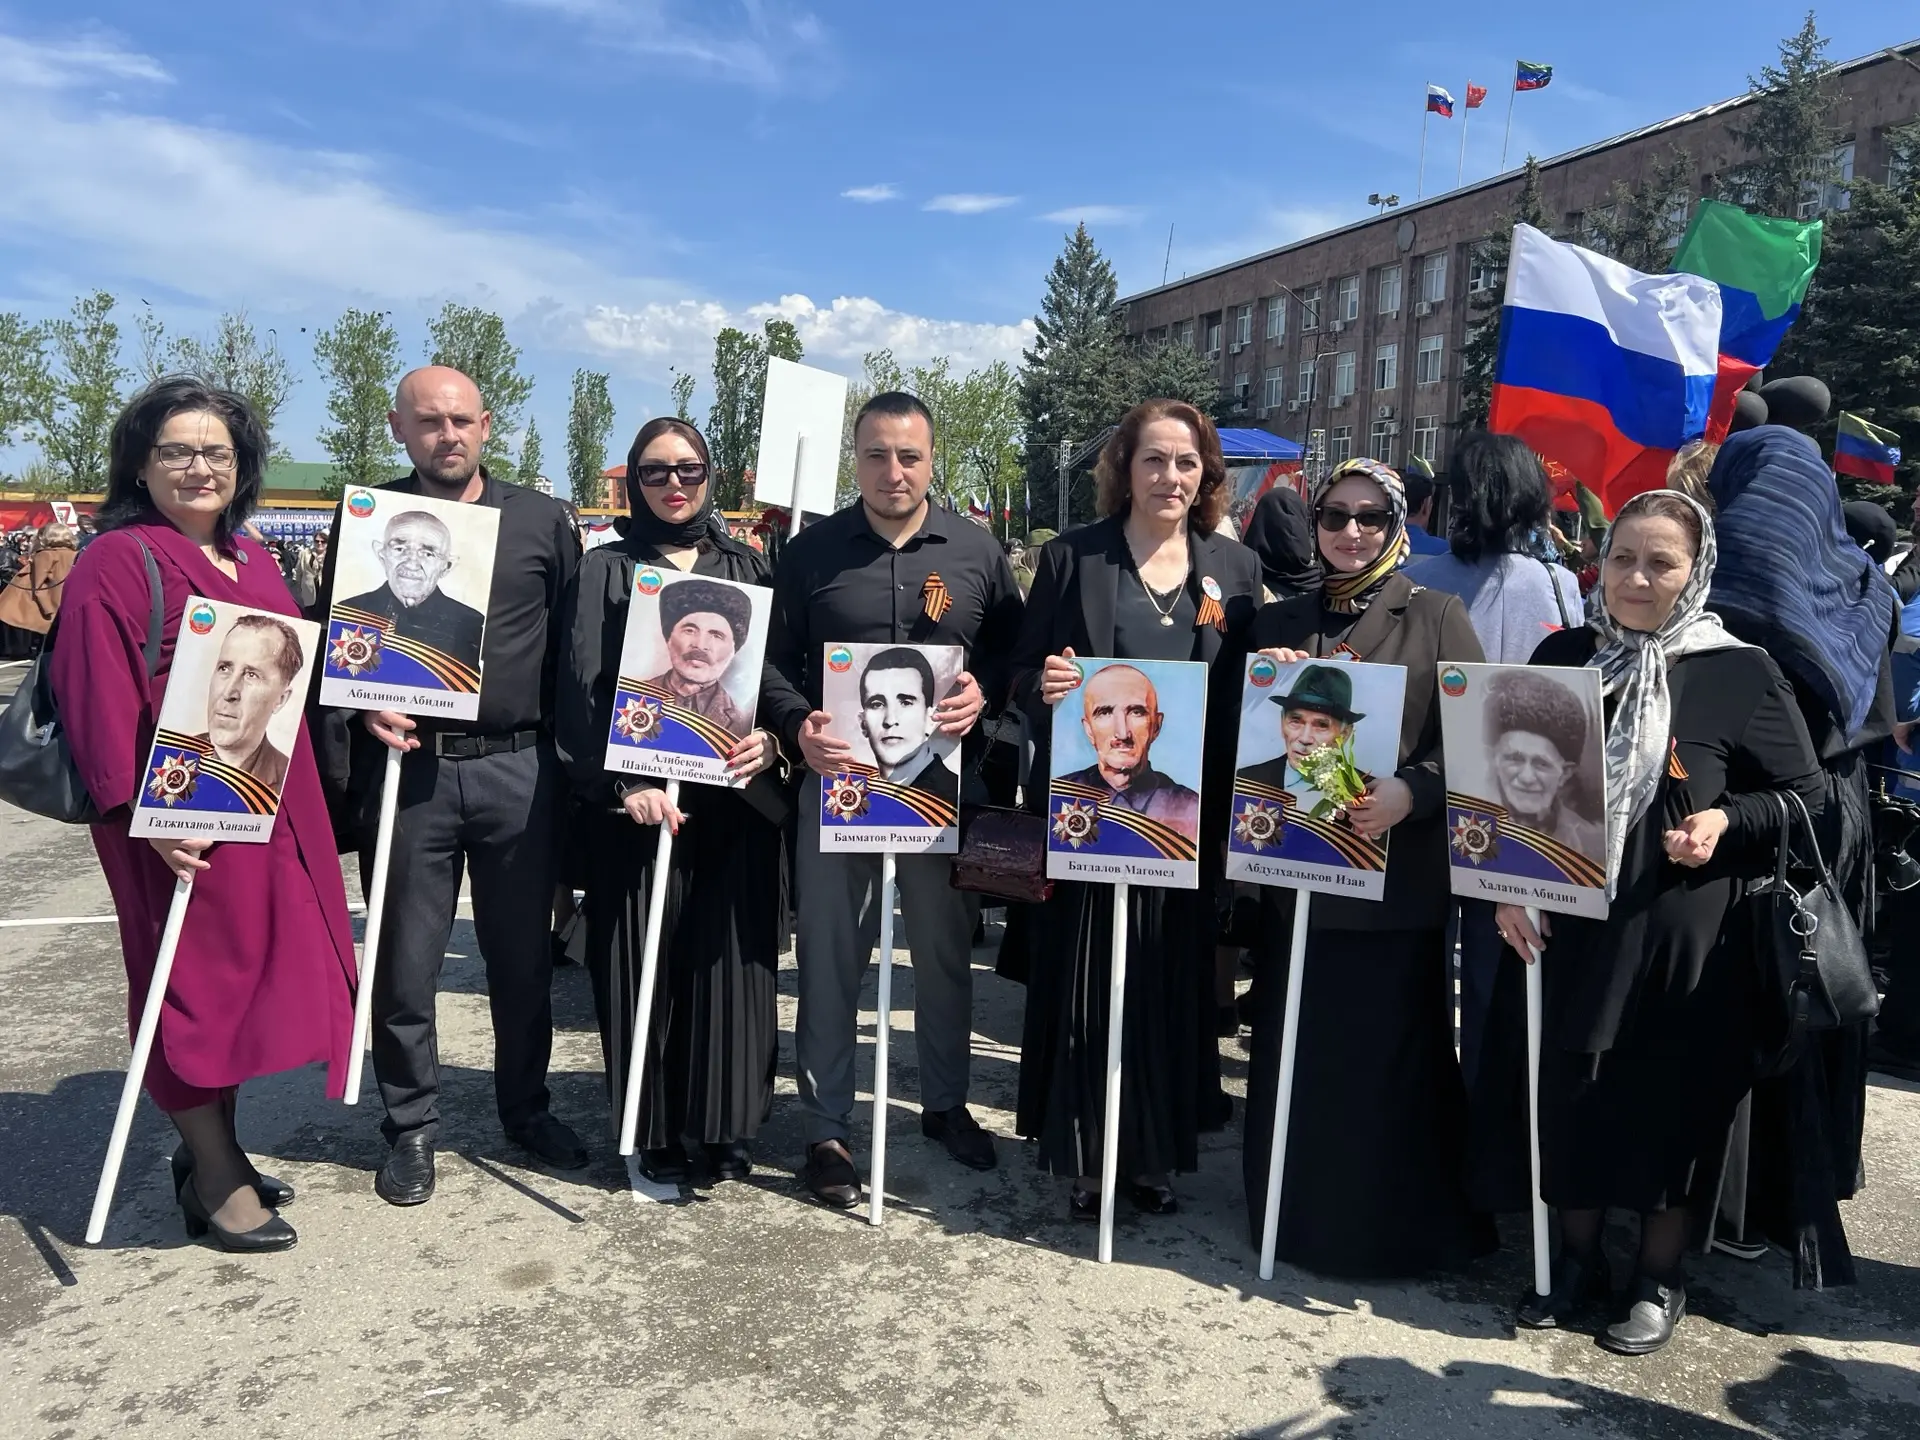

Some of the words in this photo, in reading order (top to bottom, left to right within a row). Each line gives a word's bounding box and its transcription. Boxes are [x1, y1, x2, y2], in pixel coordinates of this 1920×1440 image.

[347, 688, 406, 703] Абидинов
[409, 695, 454, 709] Абидин
[652, 753, 704, 769] Алибеков
[621, 759, 663, 774] Шайых
[664, 766, 731, 783] Алибекович
[148, 816, 215, 831] Гаджиханов
[217, 820, 262, 833] Ханакай
[834, 832, 887, 842] Бамматов
[890, 833, 945, 845] Рахматула
[1068, 860, 1121, 874] Батдалов
[1125, 864, 1176, 878] Магомед
[1244, 862, 1332, 883] Абдулхалыков
[1335, 873, 1366, 888] Изав
[1478, 878, 1528, 895] Халатов
[1531, 888, 1577, 904] Абидин
